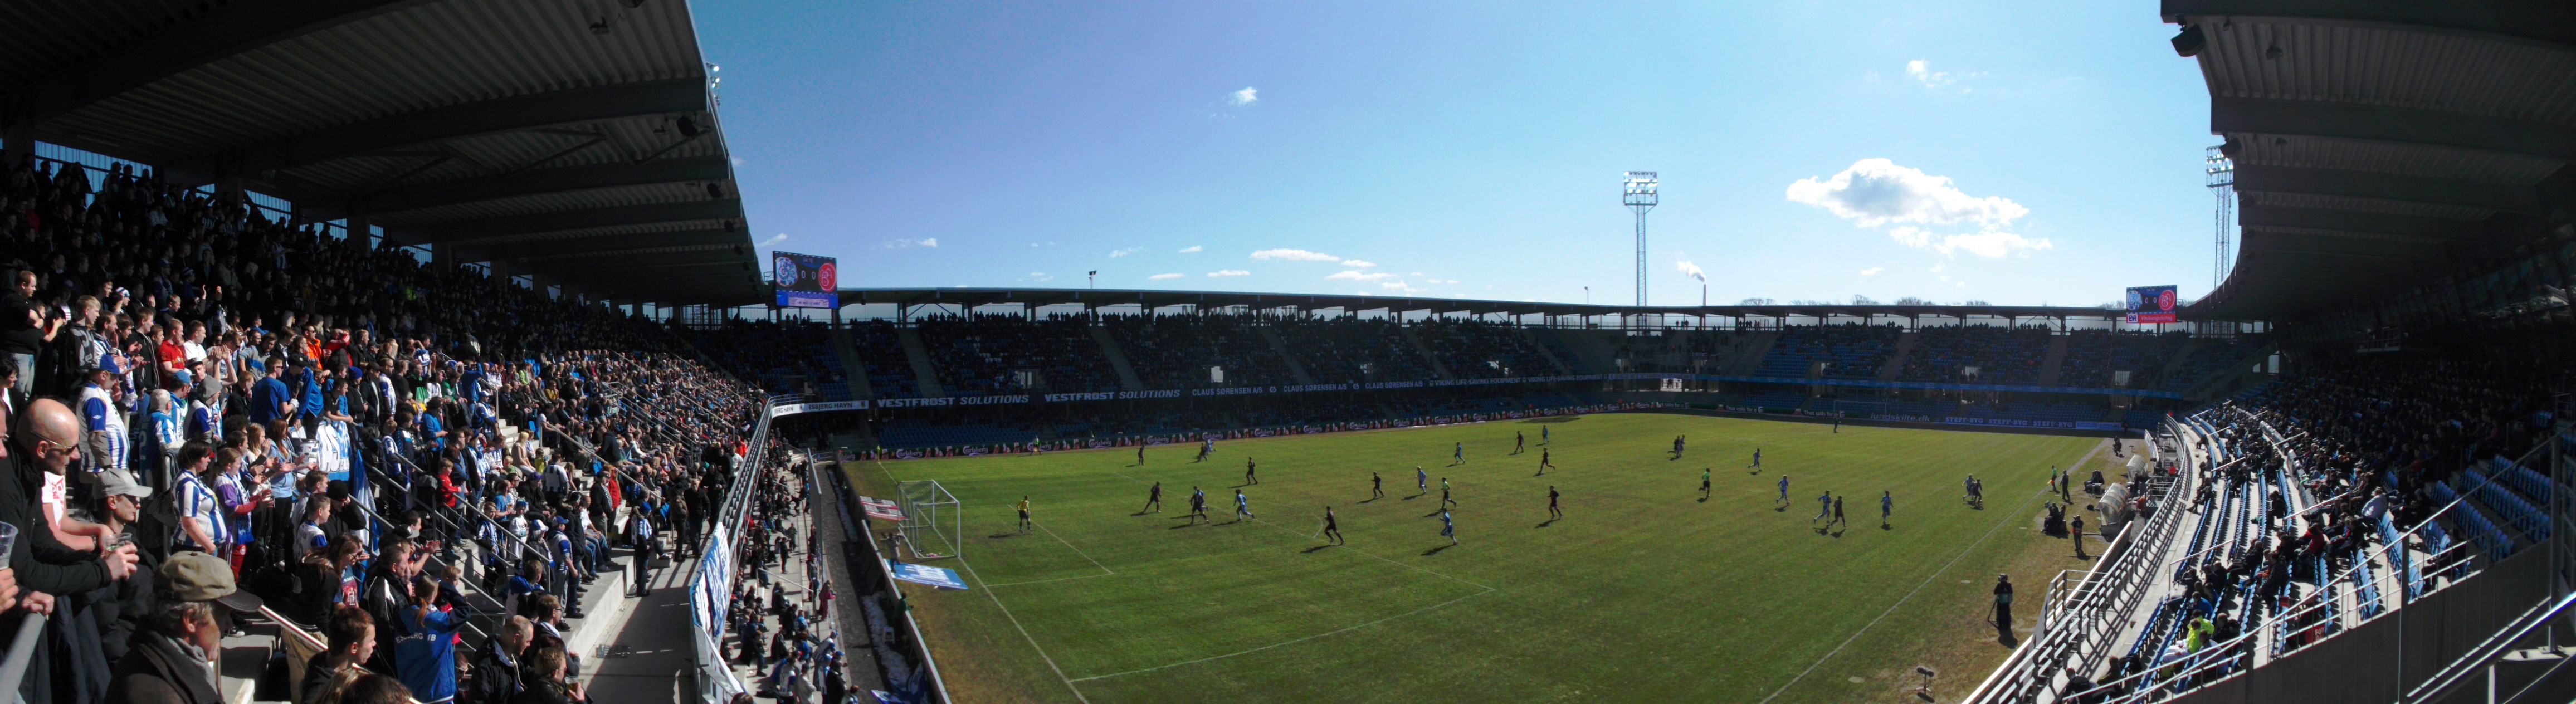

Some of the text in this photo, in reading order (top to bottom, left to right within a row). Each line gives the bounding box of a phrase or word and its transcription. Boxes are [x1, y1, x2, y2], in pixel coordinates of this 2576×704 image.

[1044, 389, 1180, 402] VESTFROST SOLUTIONS
[876, 395, 1030, 408] VESTFROST SOLUTIONS
[1870, 413, 1930, 422] lundskilte.dk
[1255, 428, 1274, 437] Carlsberg
[1303, 425, 1323, 433] Carlsberg
[1146, 436, 1169, 444] Carlsberg
[1202, 432, 1223, 441] Carlsberg
[1088, 439, 1112, 448] Carlsberg
[896, 449, 923, 459] Carlsberg
[963, 445, 988, 455] Carlsberg
